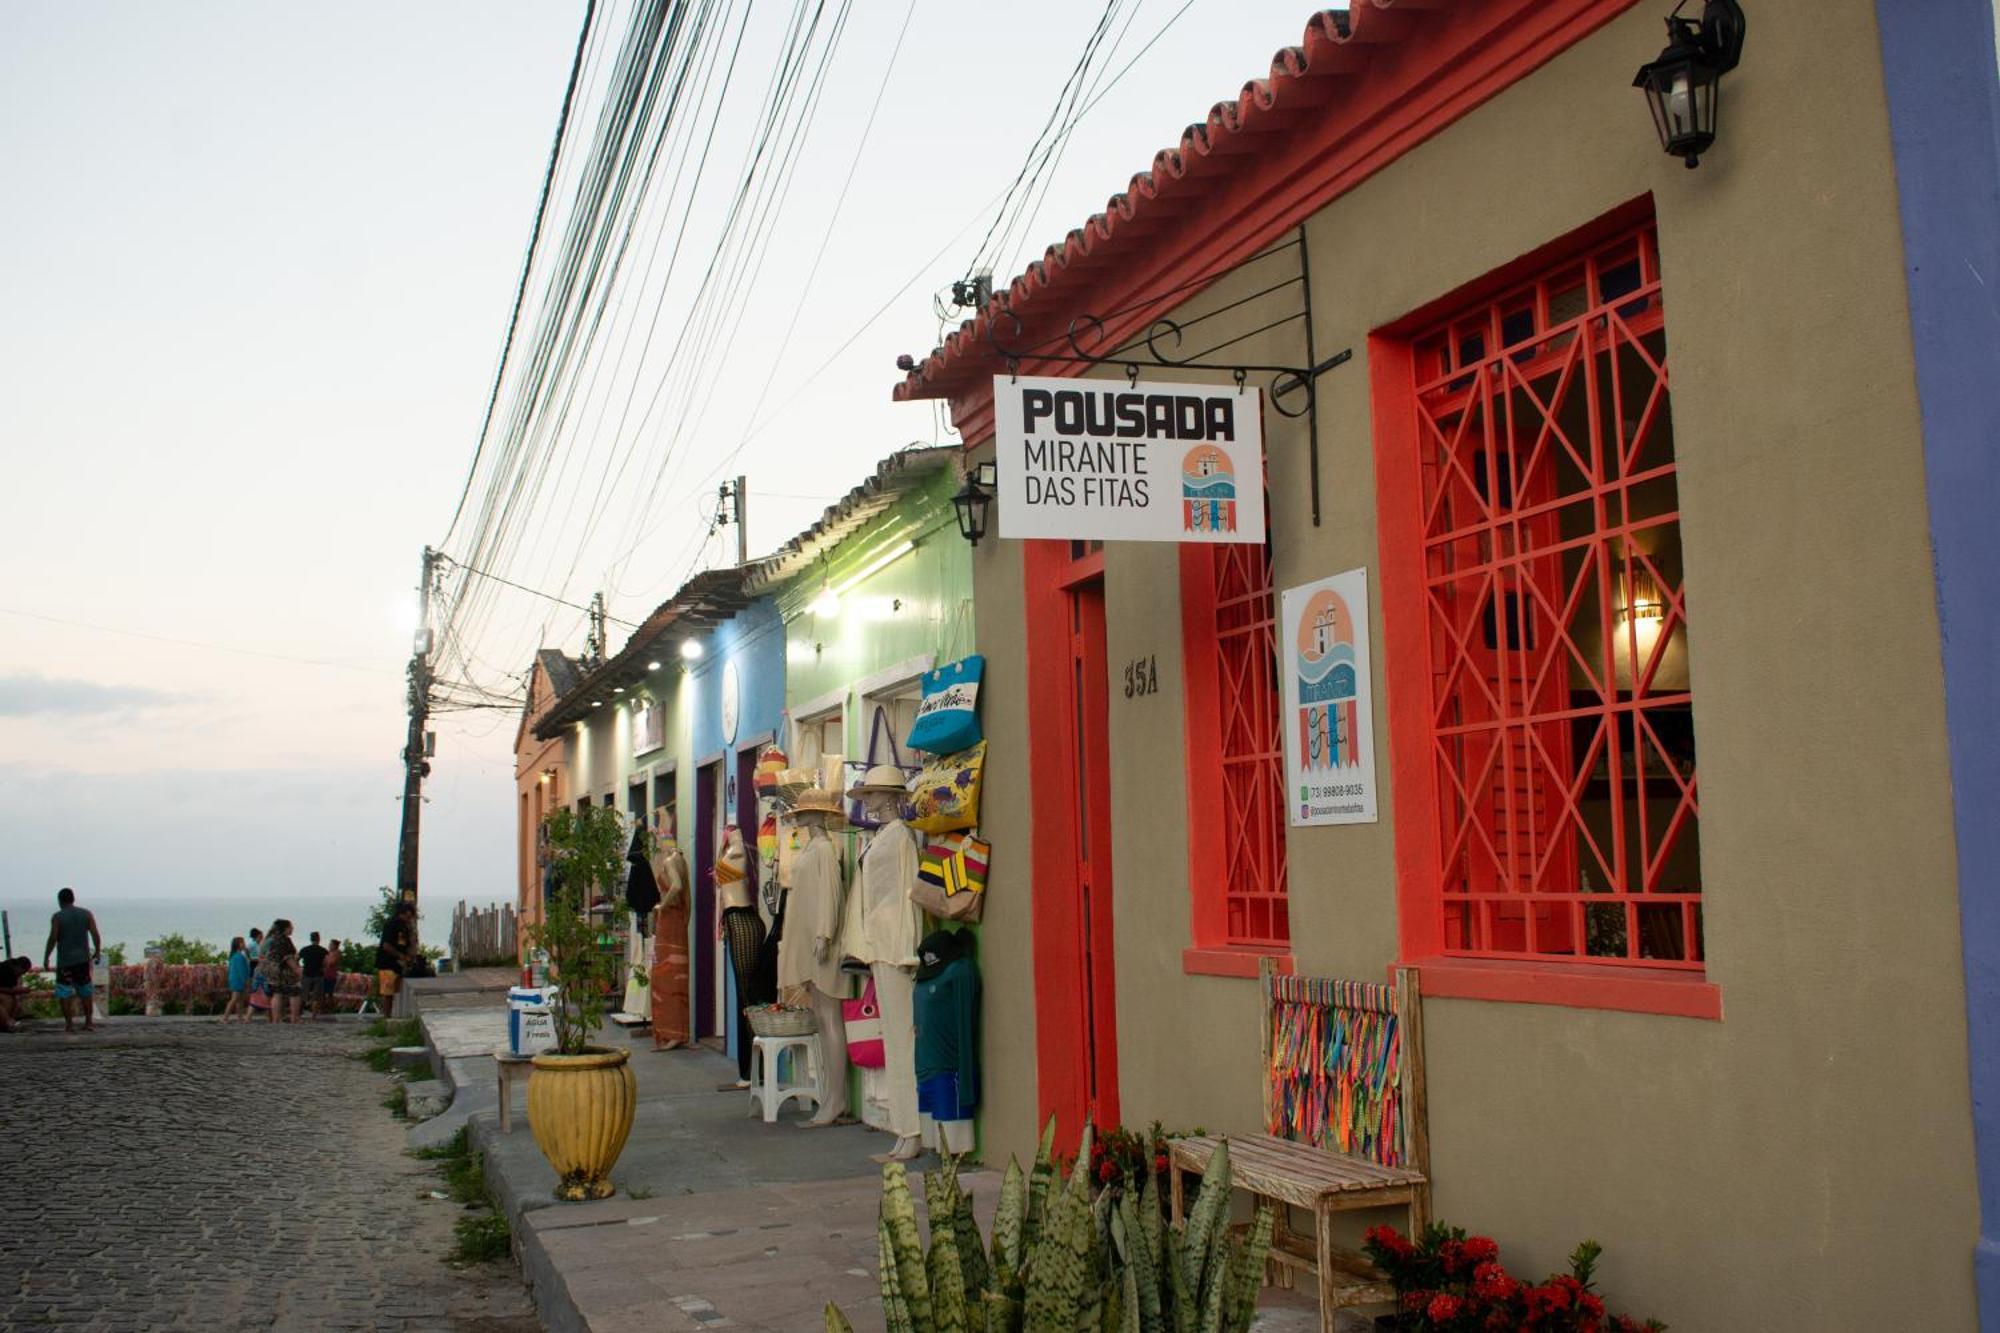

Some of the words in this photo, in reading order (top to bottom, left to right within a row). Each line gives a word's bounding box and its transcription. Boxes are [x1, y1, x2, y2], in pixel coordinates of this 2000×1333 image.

[1022, 388, 1235, 441] POUSADA
[1024, 439, 1148, 475] MIRANTE
[1025, 476, 1076, 505] DAS
[1084, 477, 1149, 508] FITAS
[1124, 654, 1158, 699] 35A
